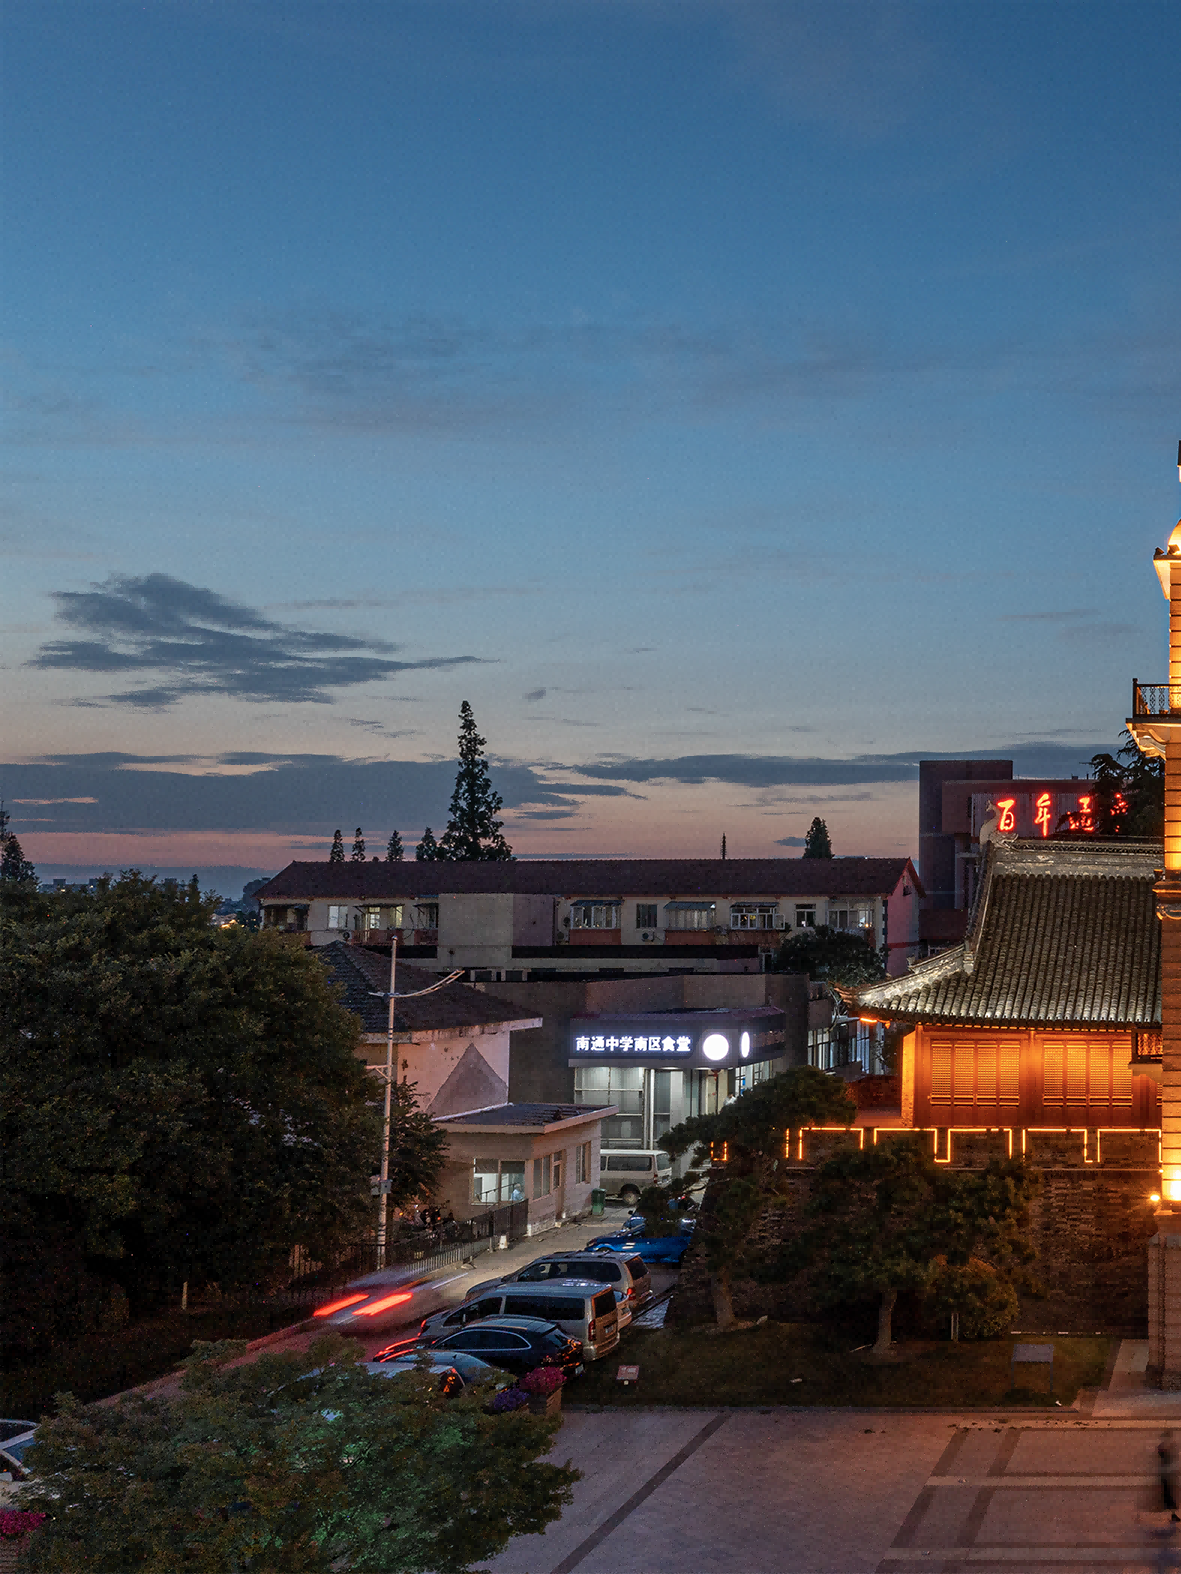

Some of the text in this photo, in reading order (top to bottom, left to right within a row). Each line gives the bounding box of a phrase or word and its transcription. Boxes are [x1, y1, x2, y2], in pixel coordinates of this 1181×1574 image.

[575, 1035, 691, 1052] 南通中学南区食堂
